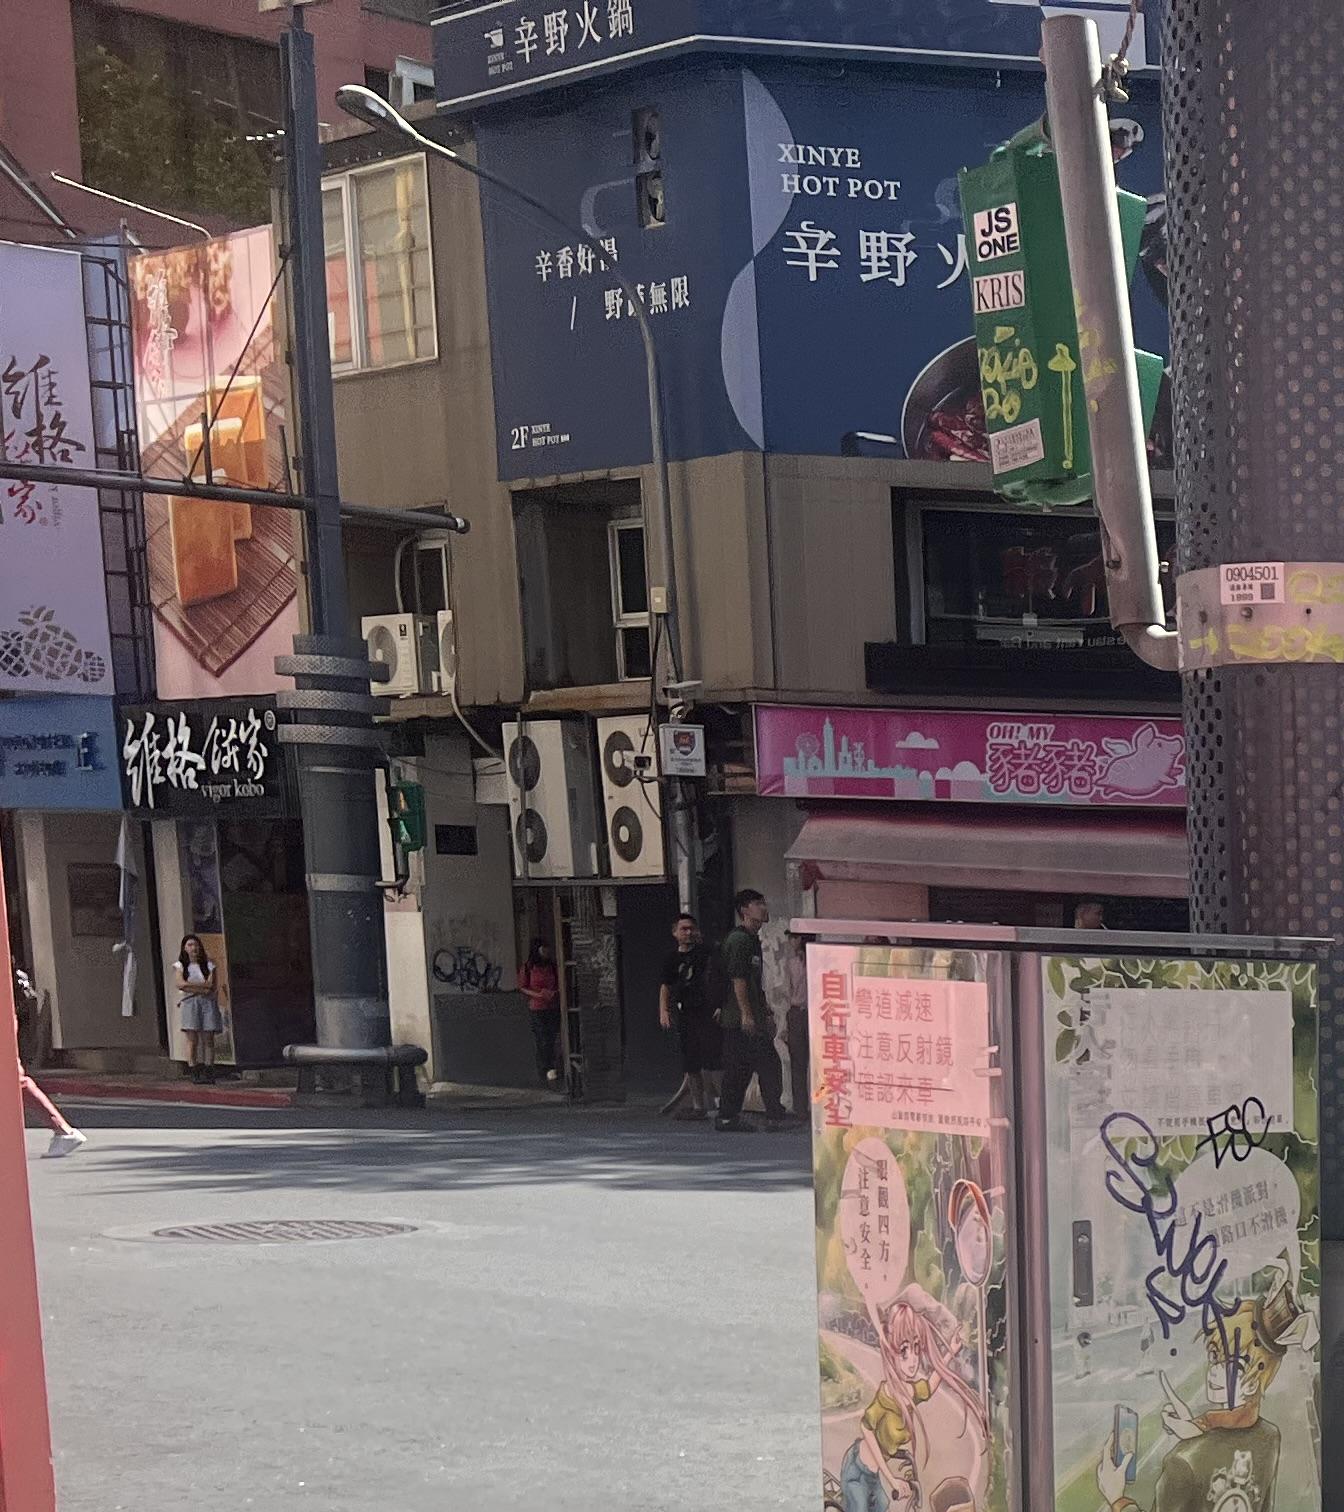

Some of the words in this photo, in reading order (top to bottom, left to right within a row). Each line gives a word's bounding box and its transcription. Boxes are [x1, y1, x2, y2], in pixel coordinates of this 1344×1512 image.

[514, 0, 634, 63] 辛野火鍋
[777, 143, 862, 169] XINYE
[781, 173, 839, 197] HOT
[848, 177, 901, 200] POT
[980, 207, 1013, 238] JS
[978, 232, 1019, 259] ONE
[974, 271, 1024, 312] KRIS
[510, 426, 529, 450] 2F
[1226, 566, 1279, 582] 0904501
[1027, 726, 1053, 741] MY
[988, 741, 1095, 795] 豬豬
[200, 784, 232, 804] vigor
[234, 779, 265, 798] kobo
[856, 988, 934, 1023] 彎道減速
[855, 1030, 954, 1067] 注意反射鏡
[857, 1071, 934, 1106] 確認來車
